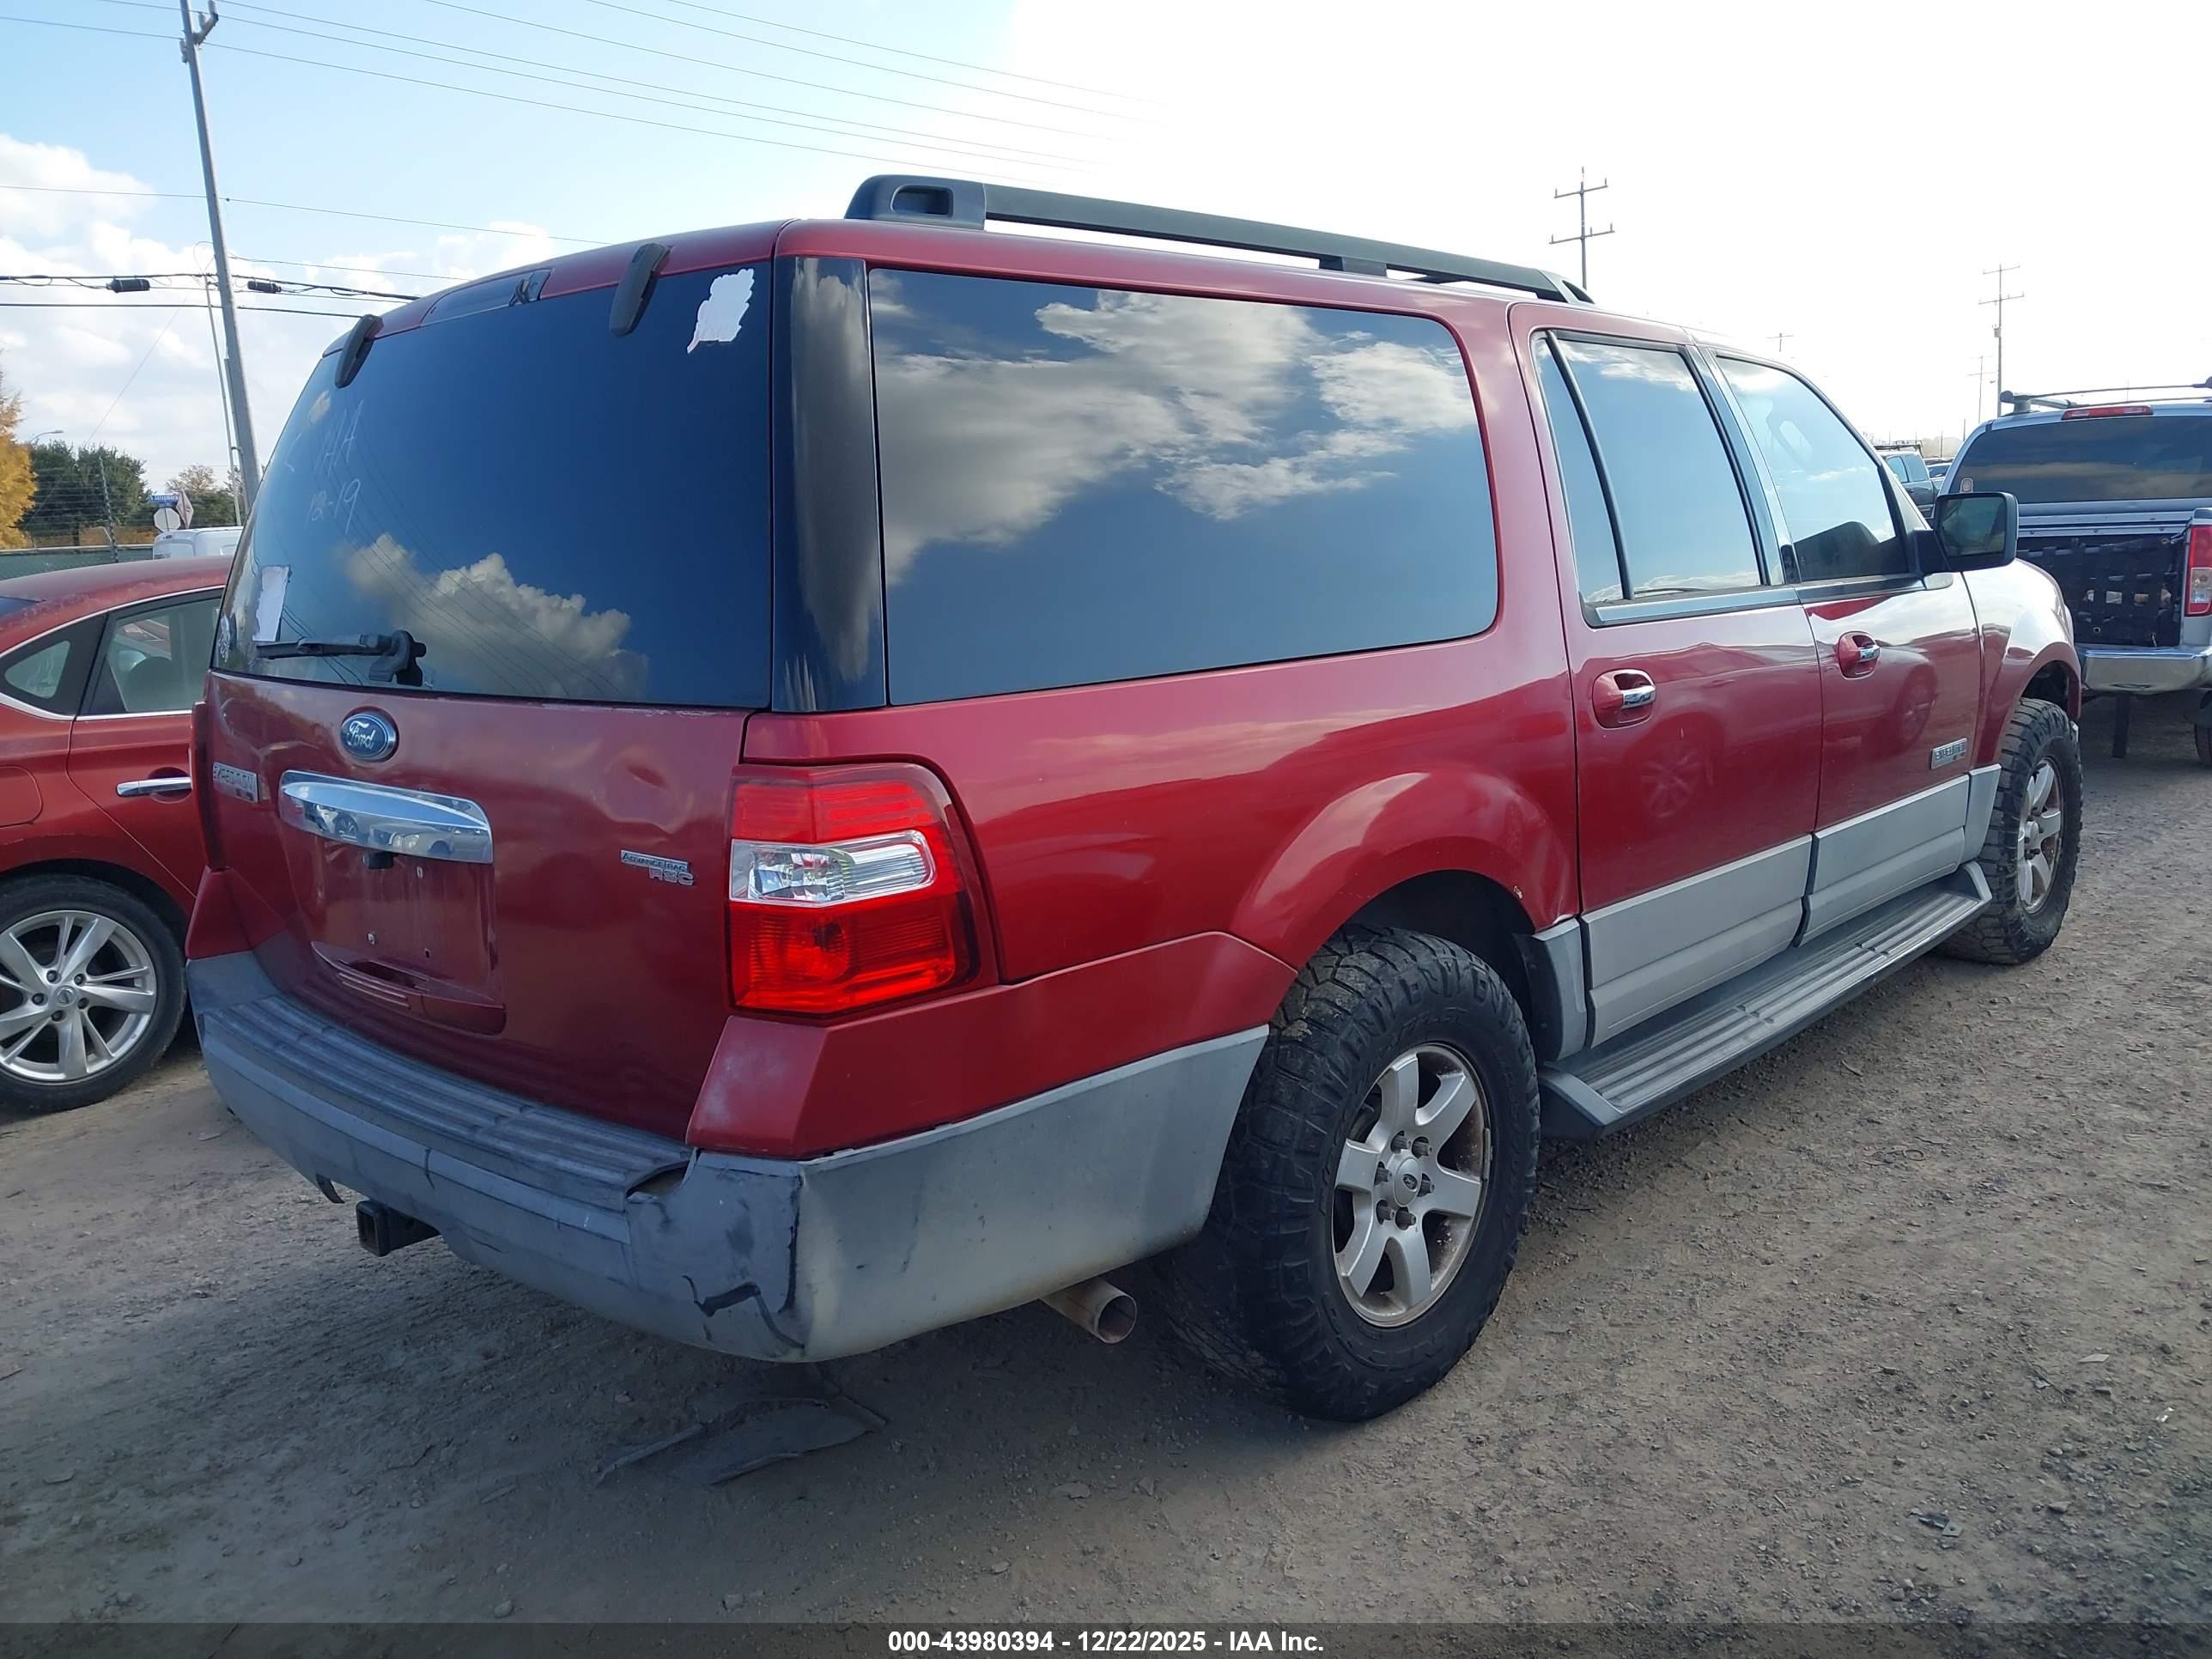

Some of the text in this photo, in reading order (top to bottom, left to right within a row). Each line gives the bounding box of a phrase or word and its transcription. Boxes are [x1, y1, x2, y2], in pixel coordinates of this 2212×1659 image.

[346, 720, 376, 748] Ford
[212, 765, 253, 787] EXPEDON
[649, 866, 694, 886] RSC
